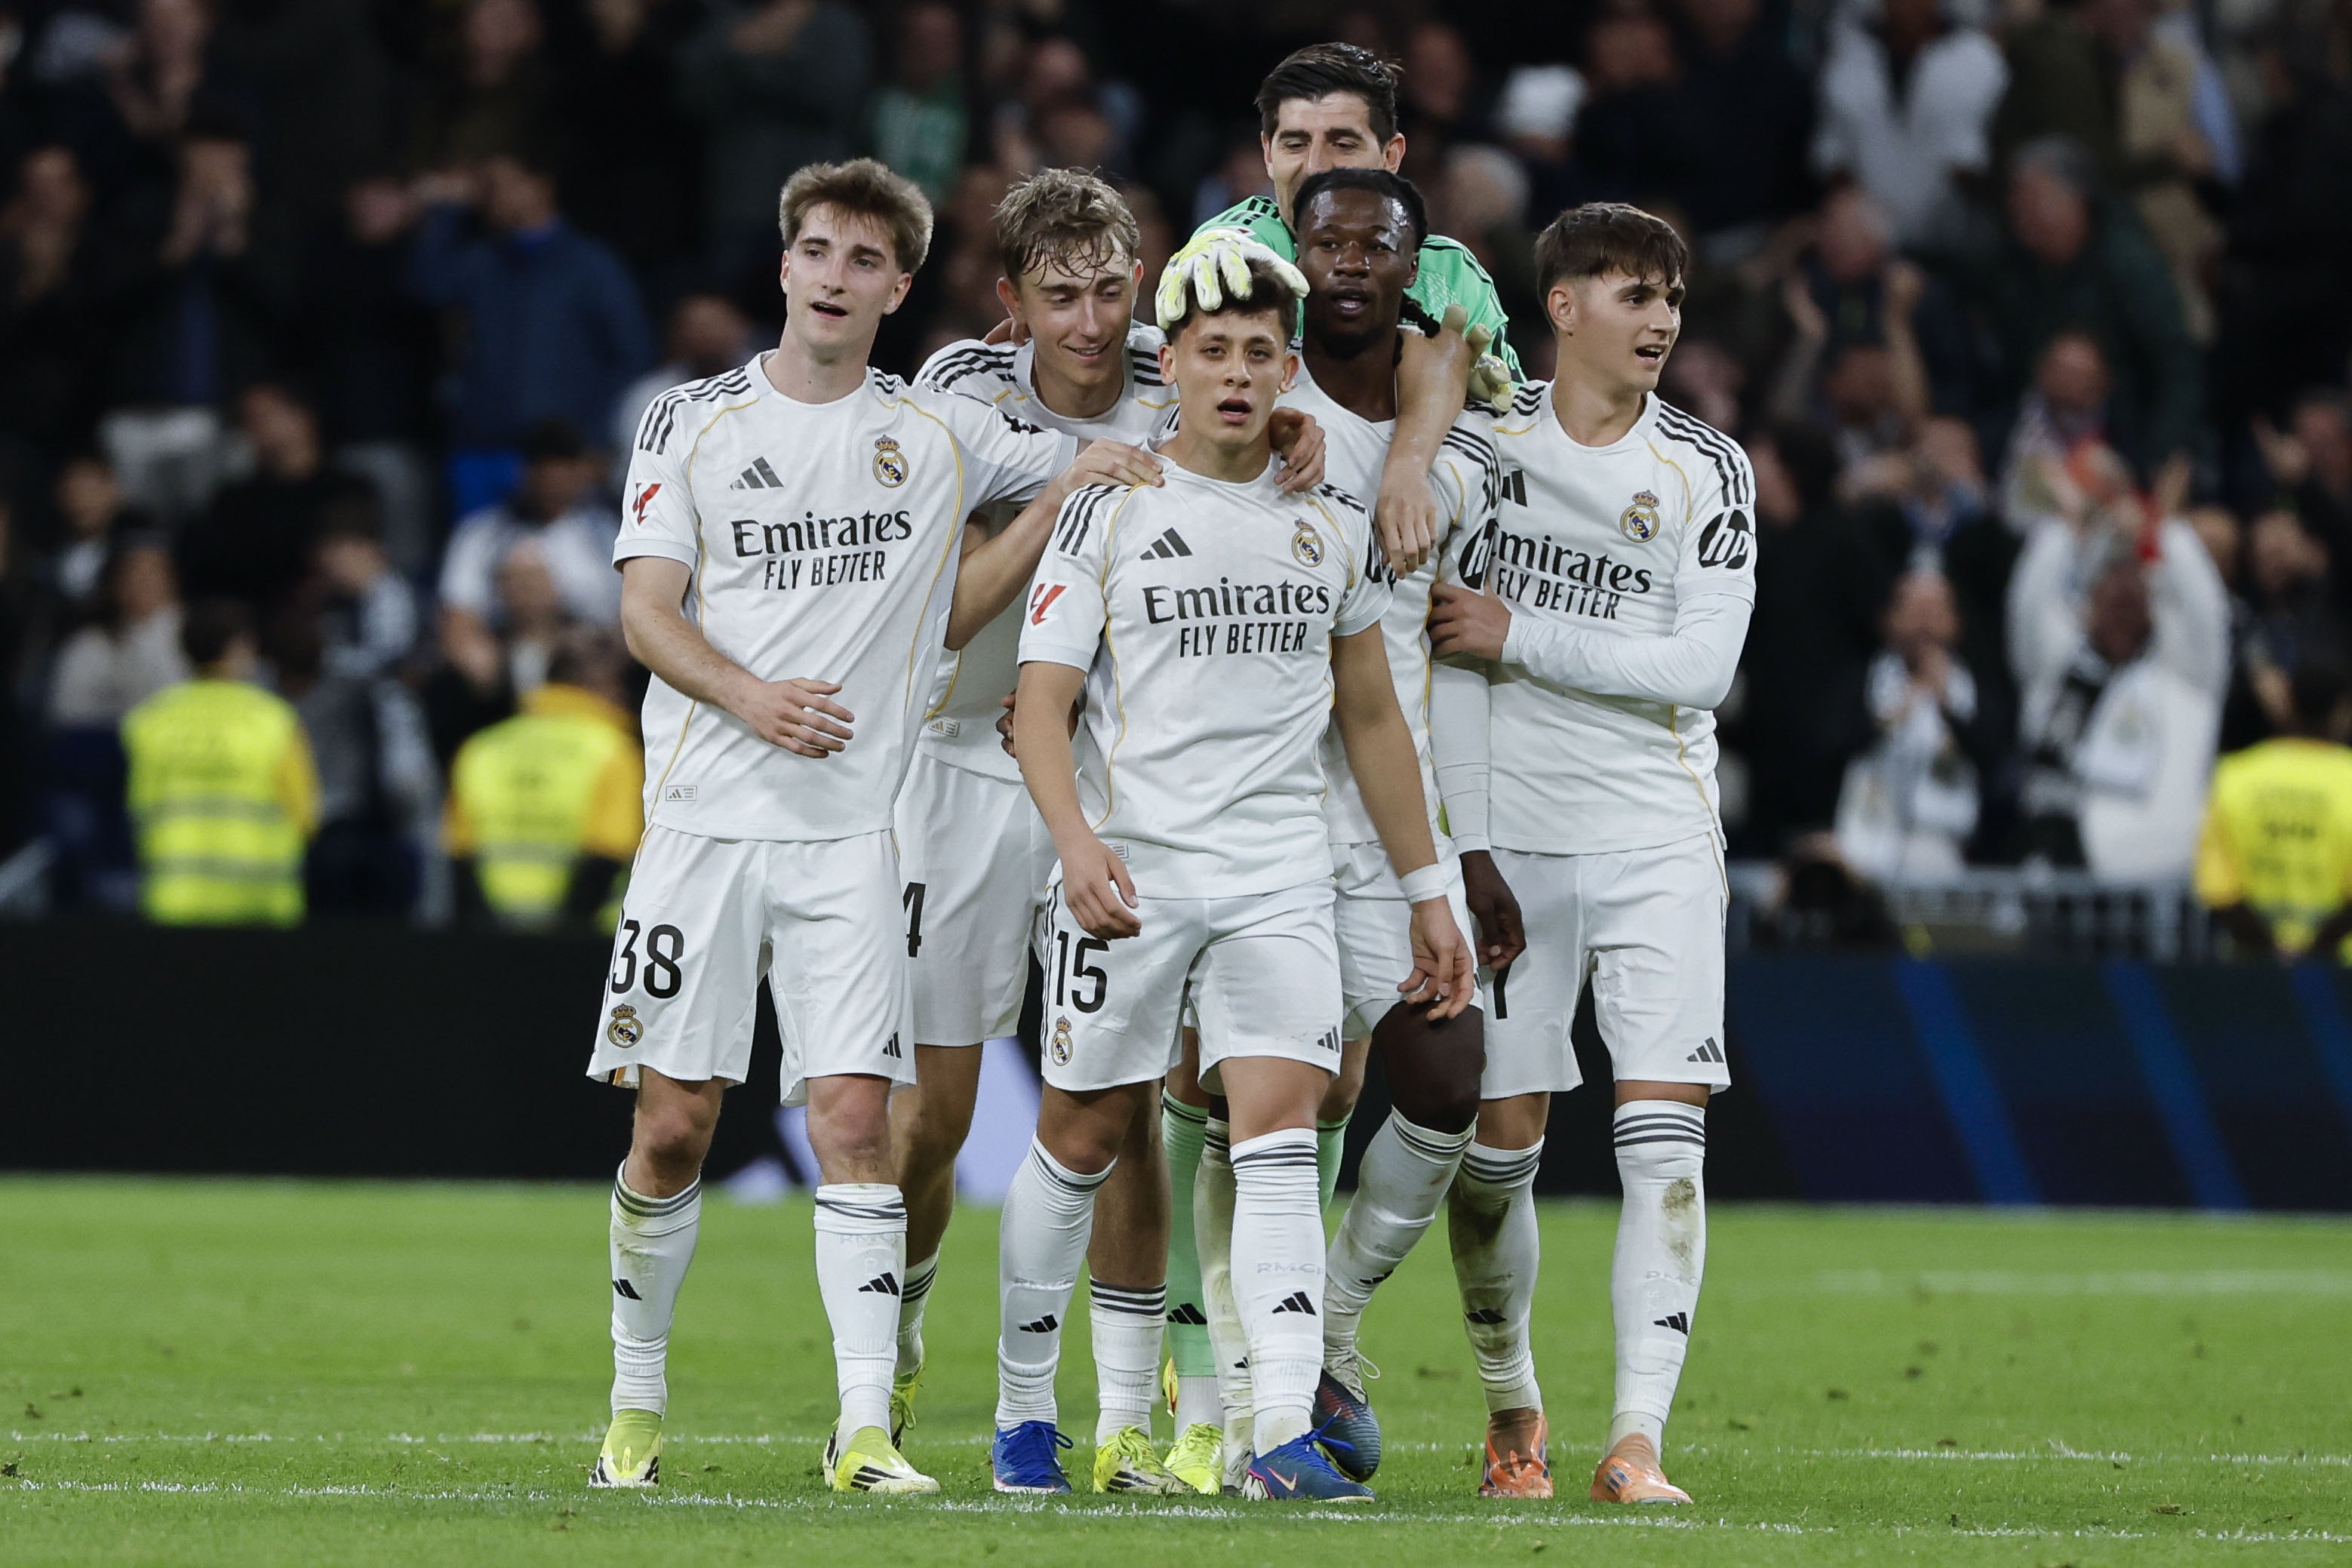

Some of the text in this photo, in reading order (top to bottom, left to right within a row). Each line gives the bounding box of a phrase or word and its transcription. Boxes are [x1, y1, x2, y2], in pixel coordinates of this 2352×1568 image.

[730, 509, 912, 558] Emirates
[1488, 522, 1653, 594] mirates
[1698, 508, 1754, 570] hp
[764, 550, 886, 590] FLY BETTER
[1496, 567, 1620, 620] FLY BETTER
[1142, 576, 1330, 625] Emirates
[1179, 621, 1308, 658] FLY BETTER
[610, 918, 685, 999] 38
[1056, 930, 1110, 1013] 15
